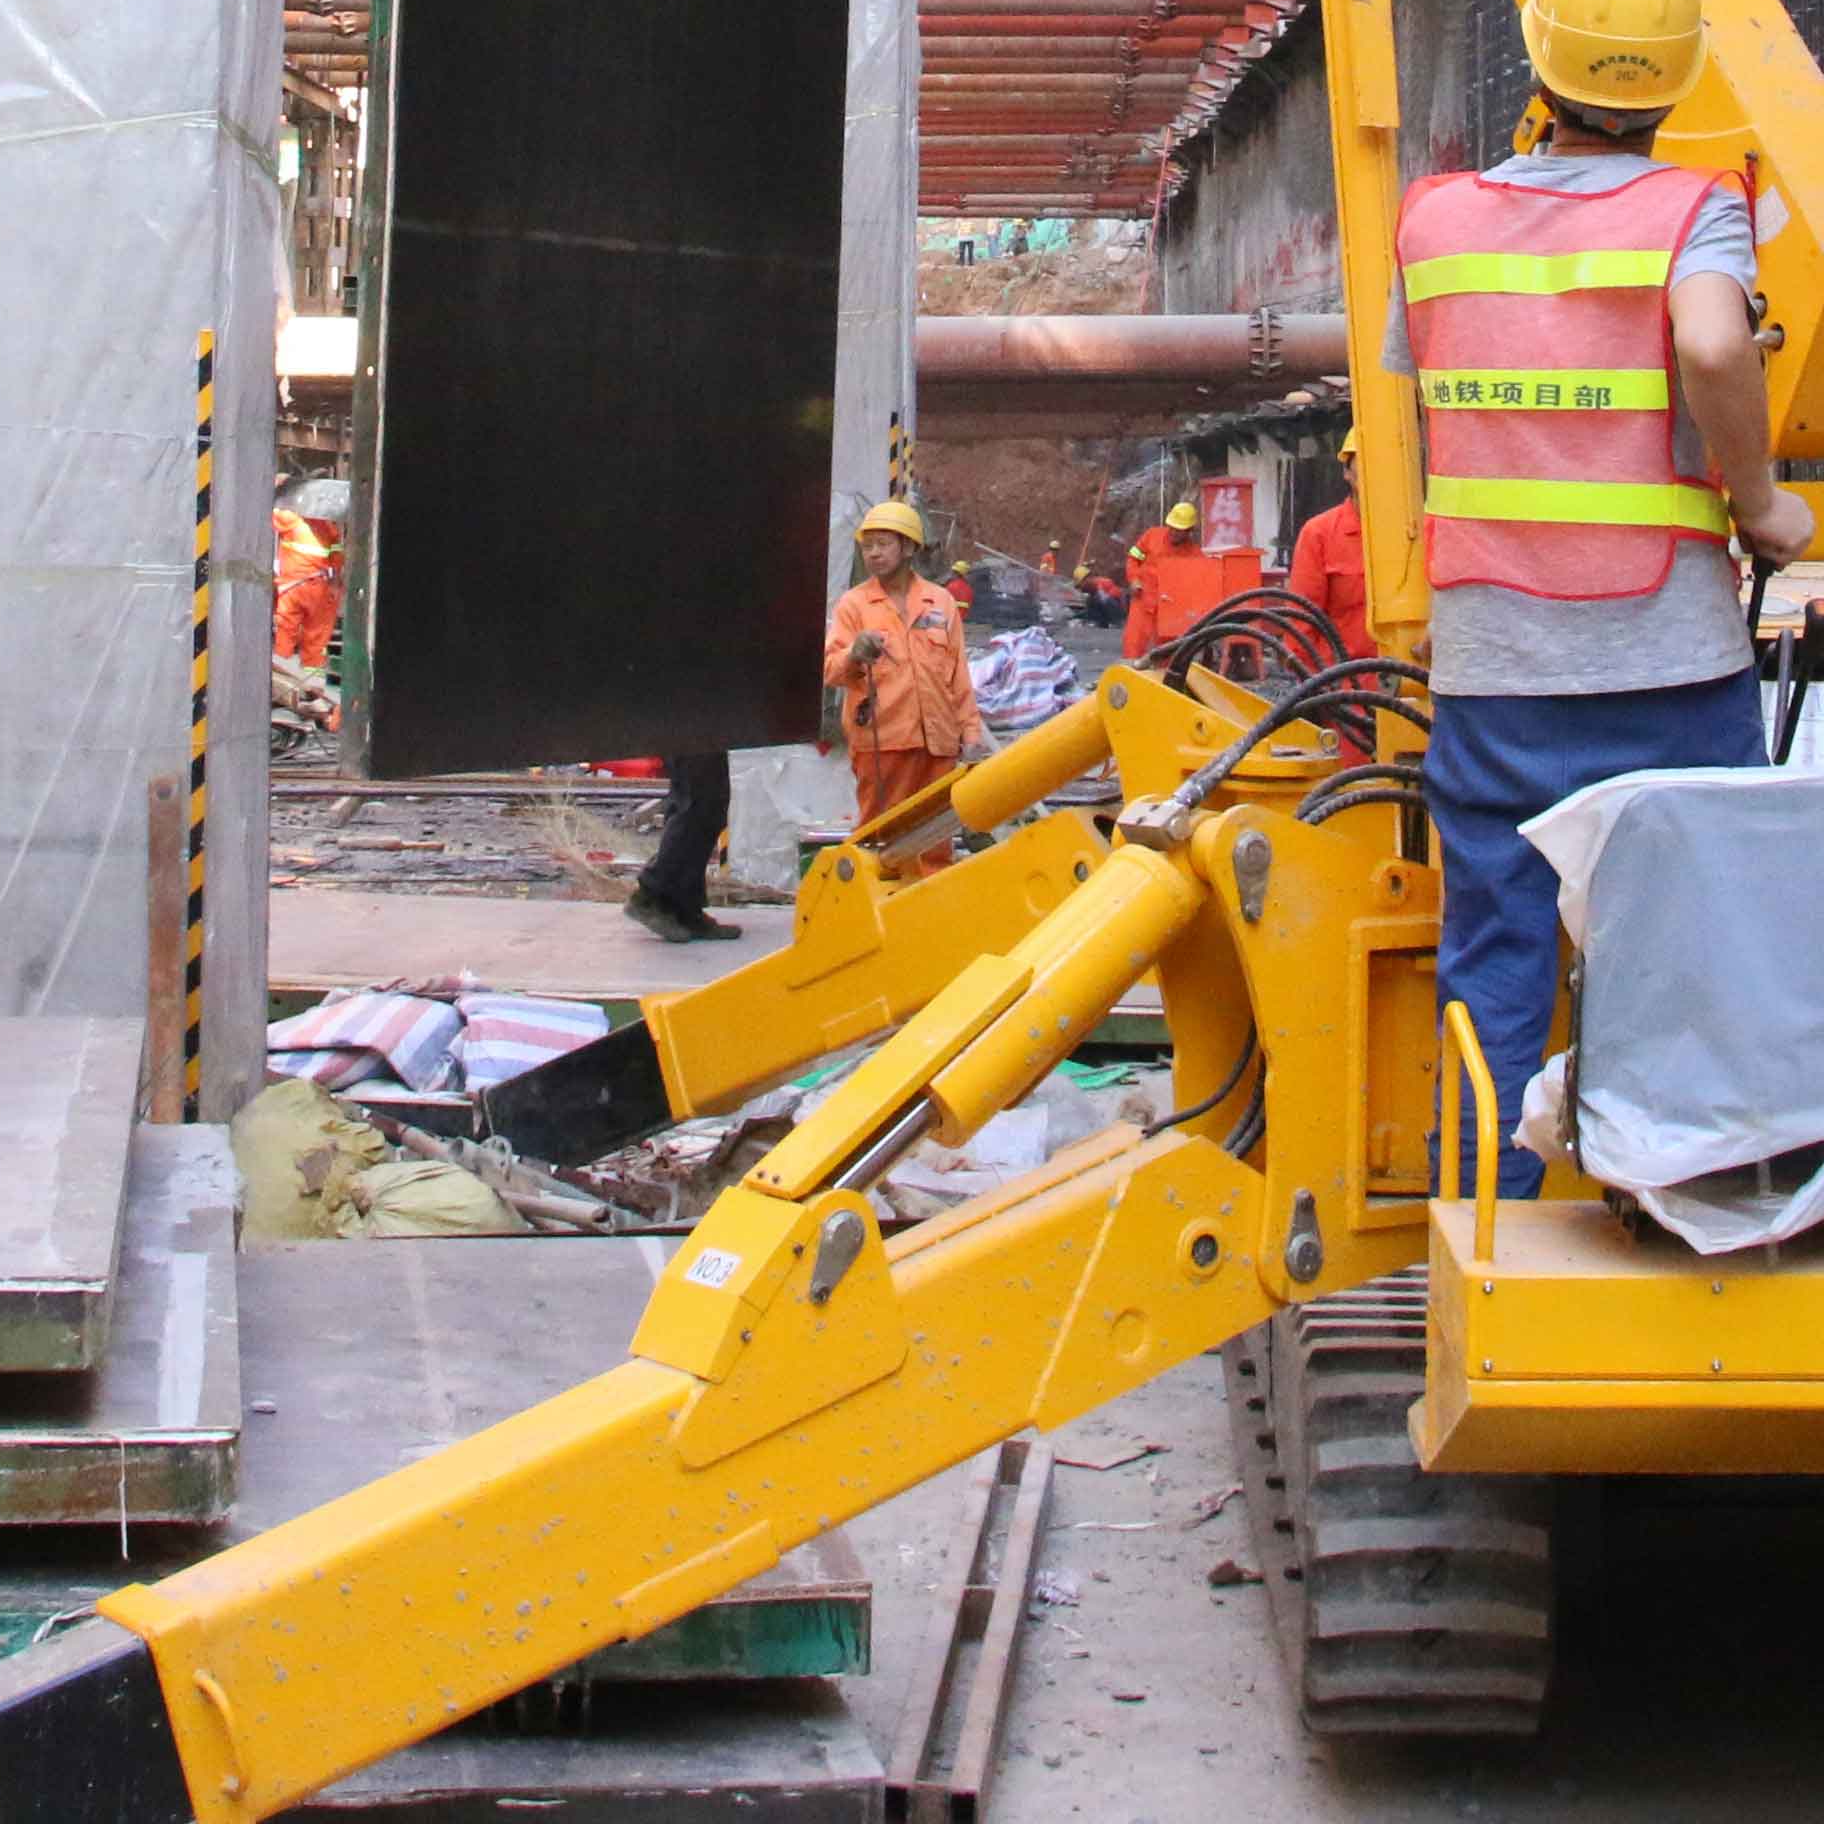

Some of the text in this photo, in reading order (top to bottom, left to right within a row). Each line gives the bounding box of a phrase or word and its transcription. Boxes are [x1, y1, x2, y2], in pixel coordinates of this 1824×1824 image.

[1433, 379, 1612, 409] 地铁项目部
